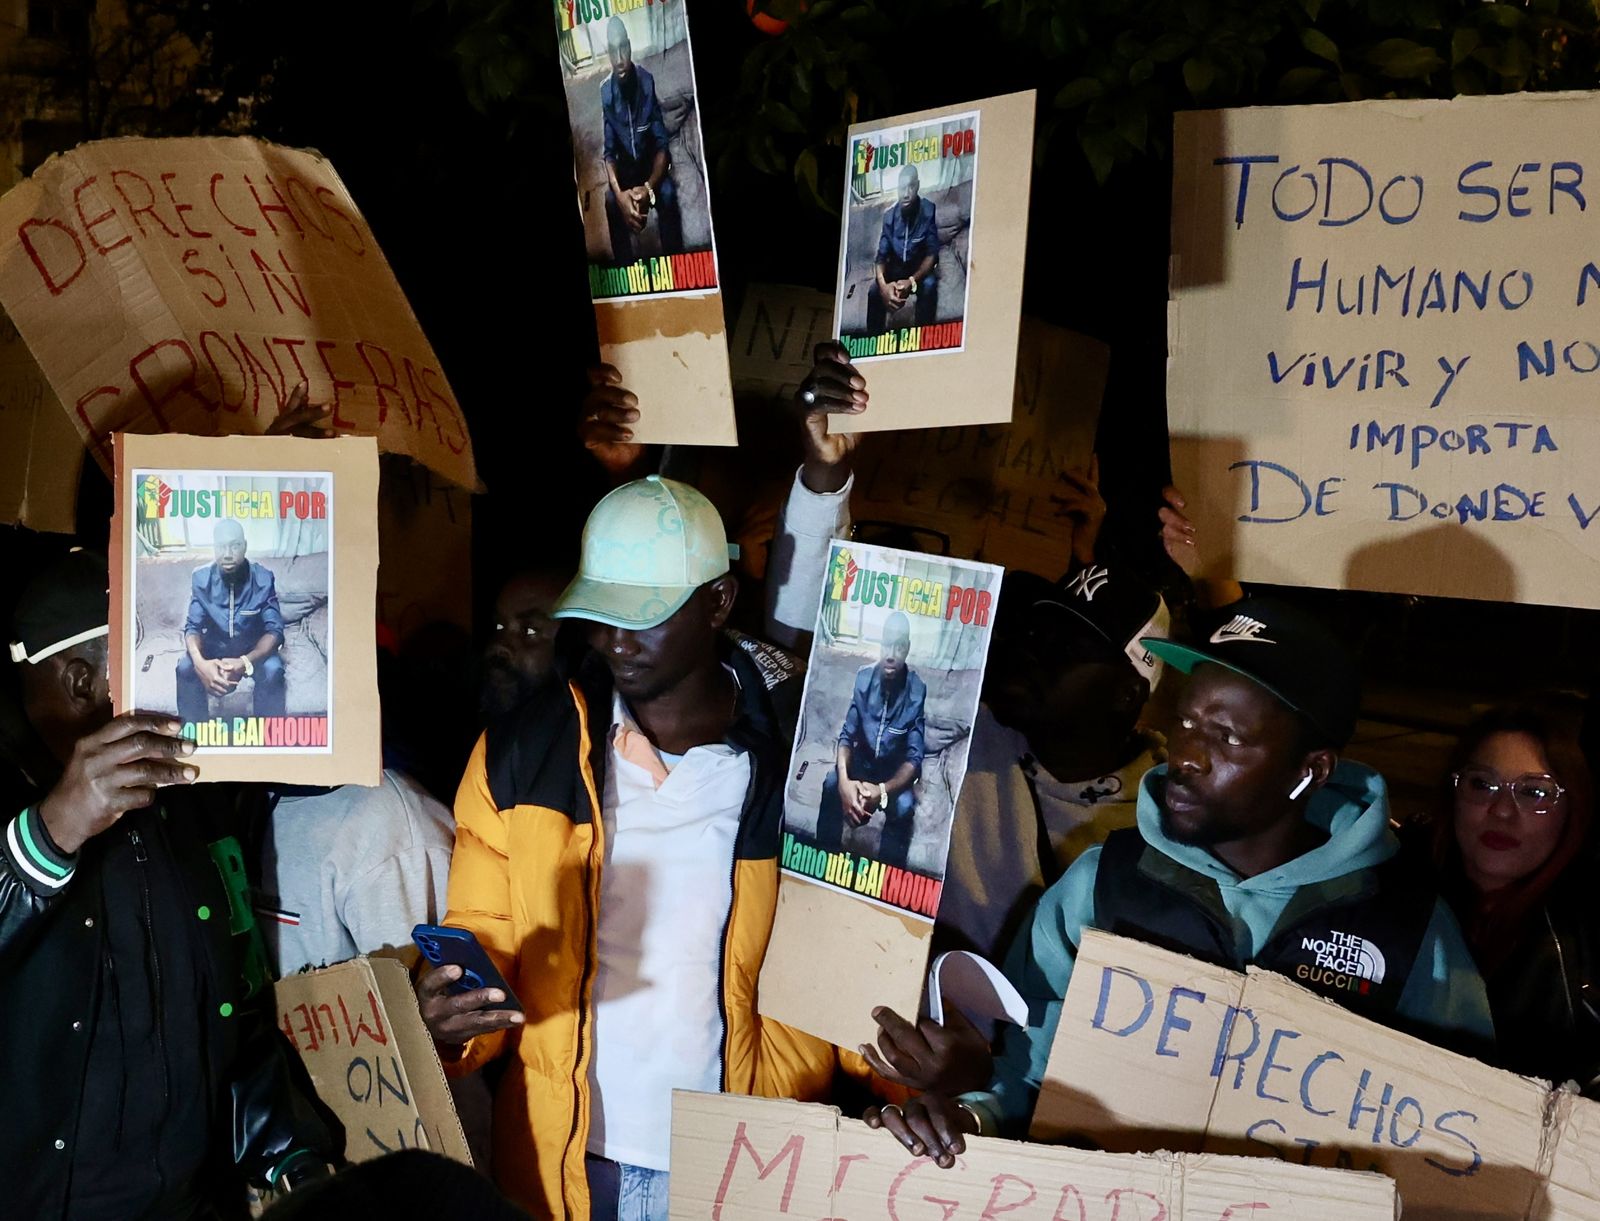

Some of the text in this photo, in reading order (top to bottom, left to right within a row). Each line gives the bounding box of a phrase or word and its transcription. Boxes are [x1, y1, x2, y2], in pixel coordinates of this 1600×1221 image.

[871, 129, 976, 171] JUSTICIA POR
[1214, 155, 1587, 230] TODO SER
[18, 170, 366, 296] DERECHOS
[1286, 257, 1535, 318] HUMANO
[1516, 339, 1600, 382] NO
[75, 330, 468, 467] FRONTERAS
[1349, 420, 1558, 470] IMPORTA
[170, 489, 327, 520] JUSTICIA POR
[1228, 461, 1348, 524] DE
[851, 568, 992, 628] JUSTICIA POR
[754, 651, 779, 670] KEEP
[179, 717, 229, 747] outh
[1301, 937, 1360, 963] NORTH
[1330, 929, 1362, 950] THE
[1296, 963, 1354, 992] GUCCI
[1315, 953, 1358, 976] FACE
[347, 1055, 409, 1109] NO
[1091, 965, 1484, 1178] DERECHOS
